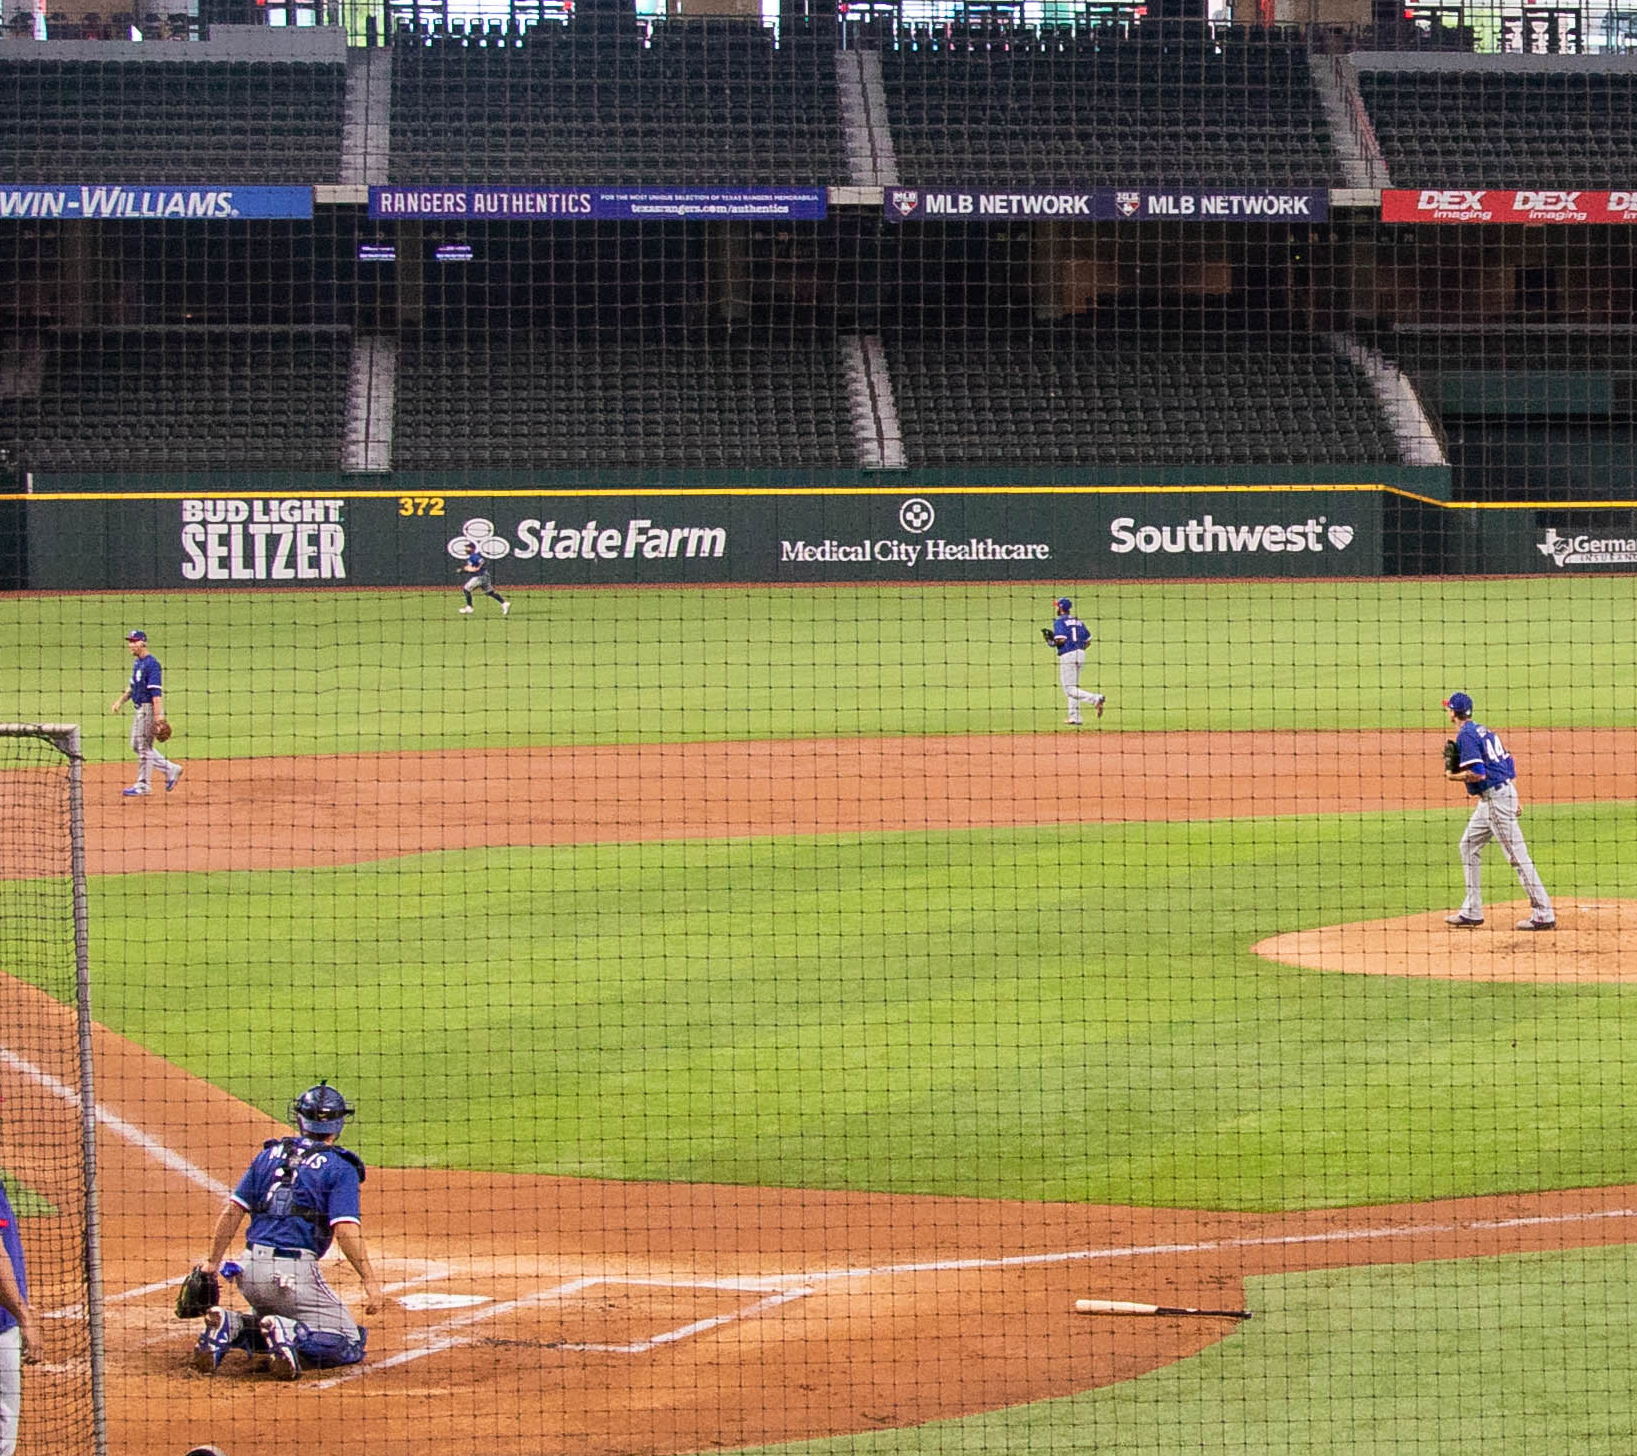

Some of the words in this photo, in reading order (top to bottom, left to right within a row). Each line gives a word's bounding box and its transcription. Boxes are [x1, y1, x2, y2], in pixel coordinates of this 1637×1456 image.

[380, 193, 466, 214] RANGERS
[474, 193, 592, 214] AUTHENTICS
[926, 195, 974, 214] MLB
[980, 195, 1090, 214] NETWORK
[1148, 195, 1195, 215] MLB
[1201, 195, 1309, 215] NETWORK
[1417, 190, 1488, 210] DEX
[1512, 190, 1582, 210] DEX
[1434, 209, 1493, 221] imaging
[1528, 209, 1588, 221] imaging
[182, 500, 244, 523] BUD
[253, 500, 344, 523] LIGHT
[399, 497, 445, 516] 372
[1110, 515, 1323, 554] Southwest
[182, 524, 346, 580] SELTZER
[781, 539, 871, 562] Medical
[875, 539, 922, 567] City
[925, 538, 1050, 560] Healthcare
[1070, 626, 1078, 642] 1
[1485, 732, 1511, 763] 44
